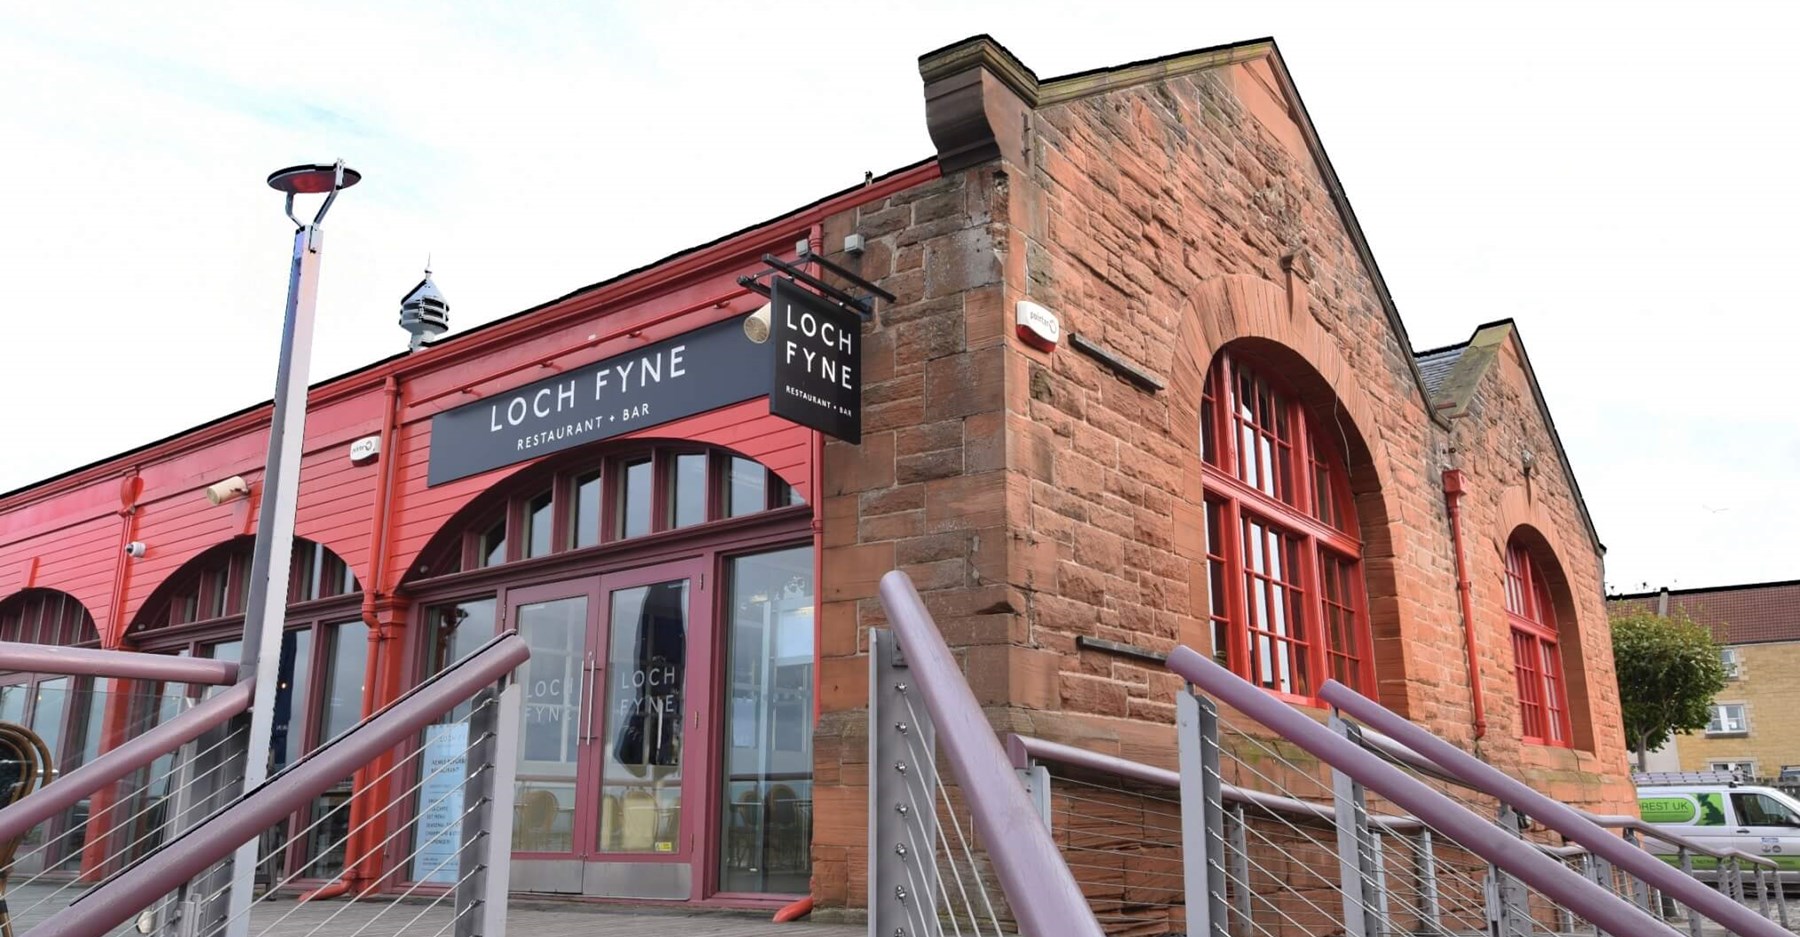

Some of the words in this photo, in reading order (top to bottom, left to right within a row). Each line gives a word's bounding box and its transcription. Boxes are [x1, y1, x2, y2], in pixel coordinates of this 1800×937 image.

[787, 304, 852, 355] LOCH
[786, 340, 852, 390] FYNE
[490, 379, 576, 432] LOCH
[595, 345, 686, 401] FYNE
[785, 385, 832, 409] RESTAURANT
[839, 406, 852, 417] BAR
[517, 416, 603, 451] RESTAURANT
[622, 403, 650, 421] BAR
[622, 666, 675, 689] LOCH
[620, 695, 674, 716] FYNE
[1638, 801, 1669, 811] REST
[1672, 801, 1688, 811] UK
